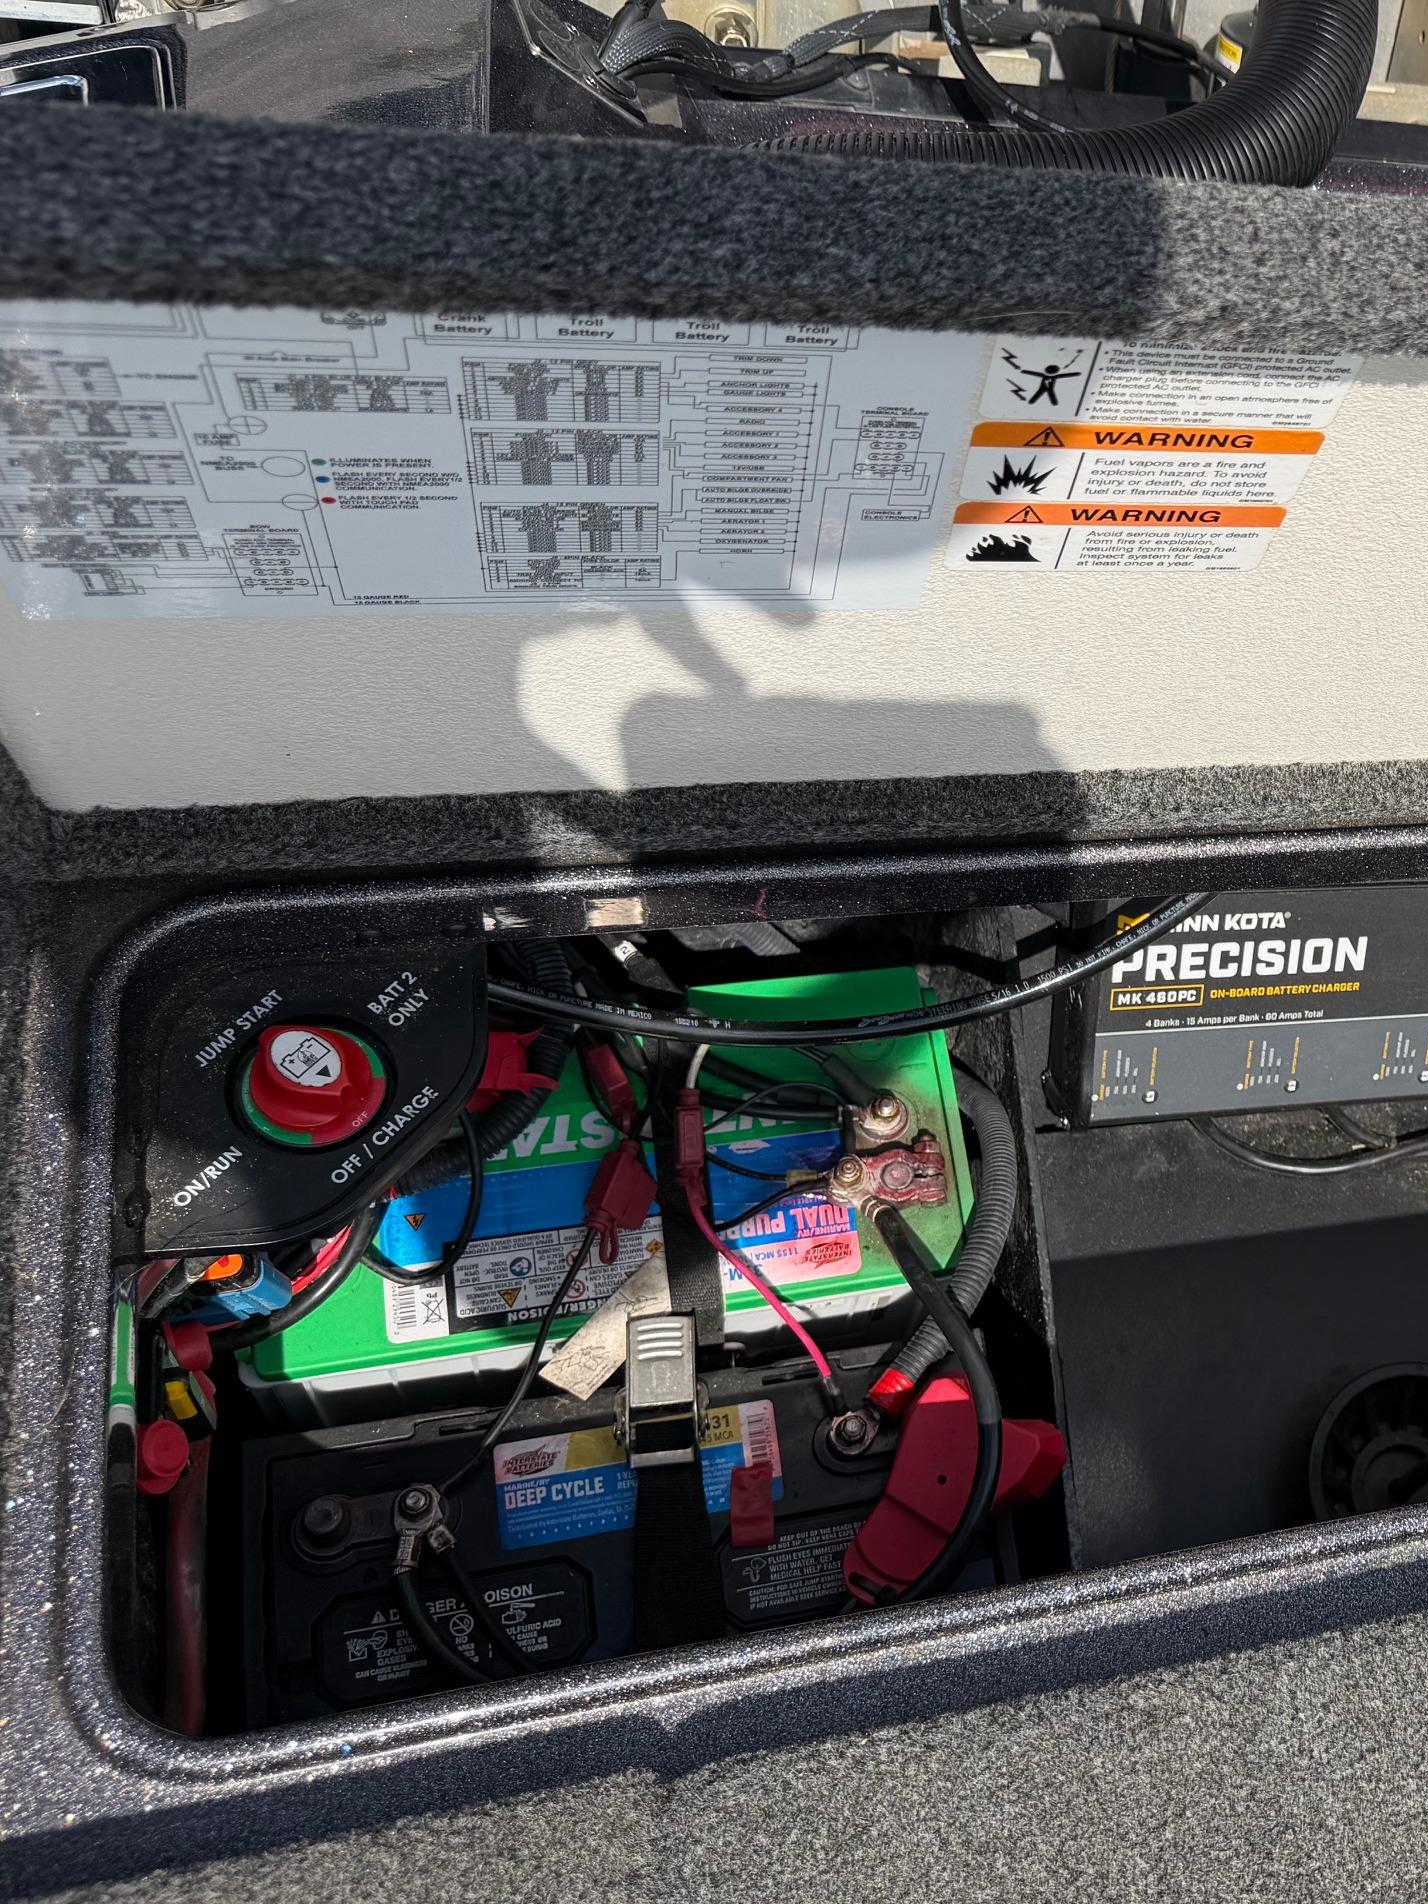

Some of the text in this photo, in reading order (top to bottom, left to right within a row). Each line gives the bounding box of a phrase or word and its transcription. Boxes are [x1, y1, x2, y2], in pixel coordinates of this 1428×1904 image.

[571, 317, 603, 327] Troll
[687, 321, 720, 331] Troll
[434, 324, 492, 336] Battery
[559, 328, 614, 339] Battery
[675, 331, 730, 343] Battery
[798, 325, 830, 335] Troll
[785, 335, 838, 346] Battery
[1138, 359, 1172, 367] Circuit
[1175, 361, 1218, 370] Interrupt
[1221, 362, 1253, 371] (GFCI)
[1255, 364, 1303, 373] protected
[1219, 354, 1271, 363] connected
[1297, 357, 1334, 365] Ground
[1121, 415, 1158, 423] contact
[1125, 408, 1180, 416] connection
[1095, 432, 1254, 448] WARNING
[1095, 458, 1125, 466] Fuel
[1129, 460, 1174, 469] vapors
[1091, 469, 1156, 477] explosion
[1159, 470, 1207, 478] hazard.
[1088, 478, 1125, 487] injury
[1146, 479, 1185, 488] death,
[1084, 487, 1109, 495] fuel
[1130, 488, 1198, 496] flammable
[1202, 489, 1242, 497] liquids
[1071, 509, 1222, 522] WARNING
[1173, 532, 1207, 540] injury
[1169, 546, 1210, 554] leaking
[1170, 914, 1220, 933] INN
[1111, 936, 1368, 984] PRECISION
[367, 971, 418, 1016] BATT 2
[1210, 982, 1360, 999] ON-BOARD BATTERY CHARGER
[970, 994, 990, 1009] HOSE
[1118, 992, 1142, 1005] MK
[388, 989, 430, 1028] ONLY
[627, 1007, 652, 1021] MEXICO
[1145, 1010, 1323, 1028] 4 Banks 15 Amps per Bank 60 Amps Total
[195, 989, 284, 1068] JUMP START
[352, 1111, 368, 1127] OFF
[331, 1154, 363, 1186] OFF
[371, 1085, 439, 1147] CHARGE
[173, 1146, 243, 1208] ON/RUN
[790, 1204, 849, 1229] DUAL
[798, 1224, 850, 1237] MARINE/RV
[756, 1248, 799, 1261] 1155 MCA
[502, 1451, 561, 1468] INTERSTATE
[504, 1460, 555, 1474] BATTERIES
[505, 1476, 605, 1510] DEEP CYCLE
[770, 1561, 841, 1580] MEDICAL HELP FAST
[484, 1583, 533, 1603] OISON
[506, 1621, 541, 1636] ULFURIC
